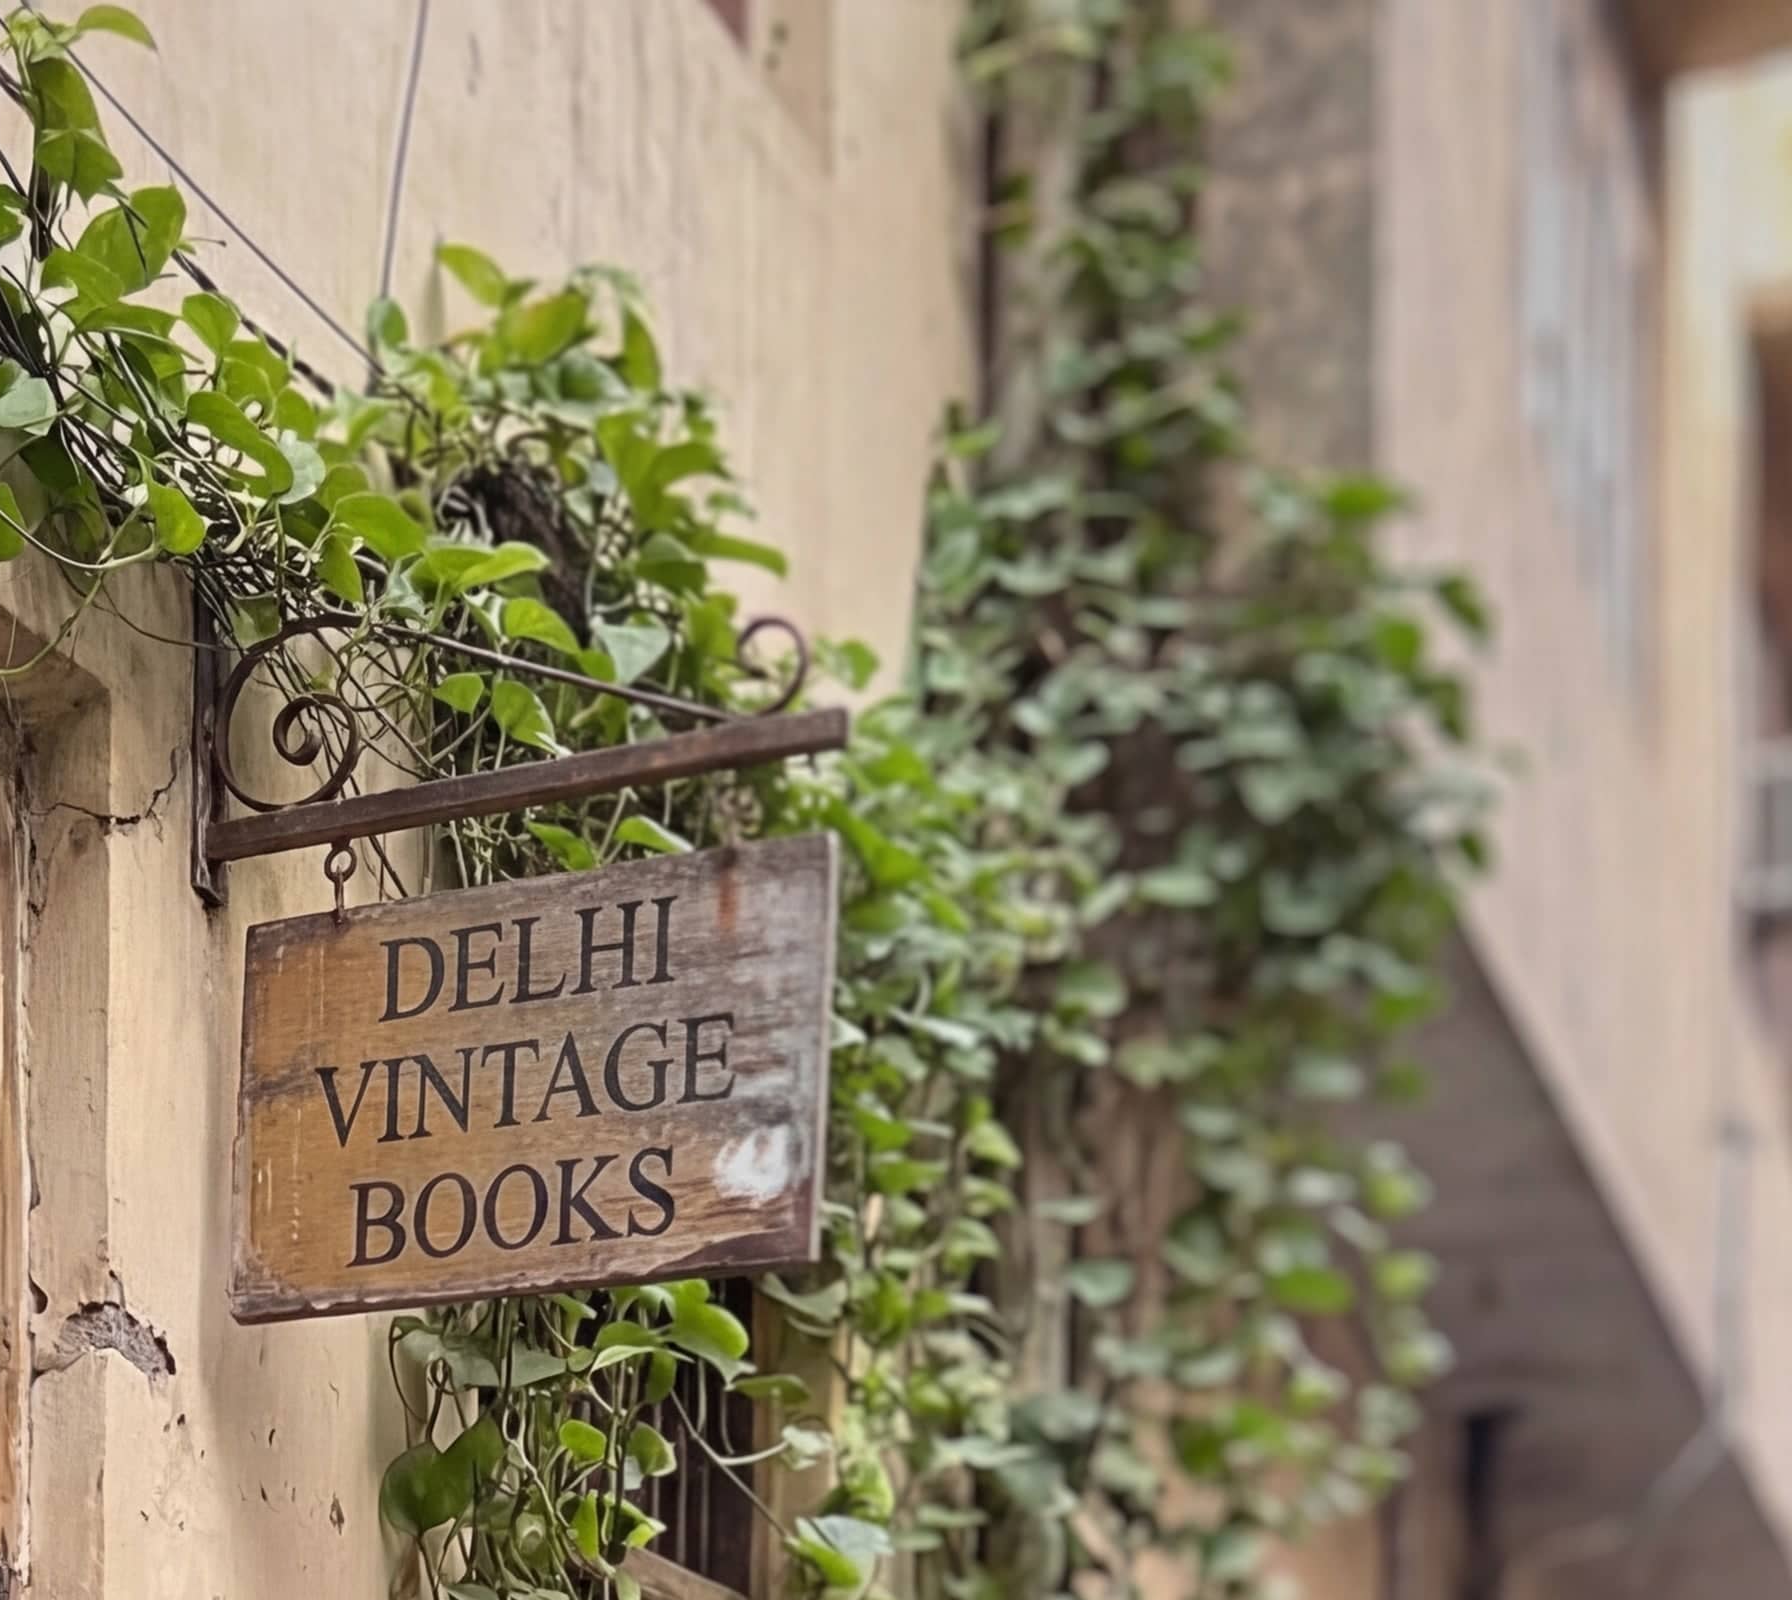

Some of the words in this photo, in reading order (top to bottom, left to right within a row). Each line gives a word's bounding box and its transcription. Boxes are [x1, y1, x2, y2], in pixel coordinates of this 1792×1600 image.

[377, 895, 678, 1023] DELHI
[314, 1012, 735, 1148] VINTAGE
[345, 1146, 676, 1269] BOOKS
